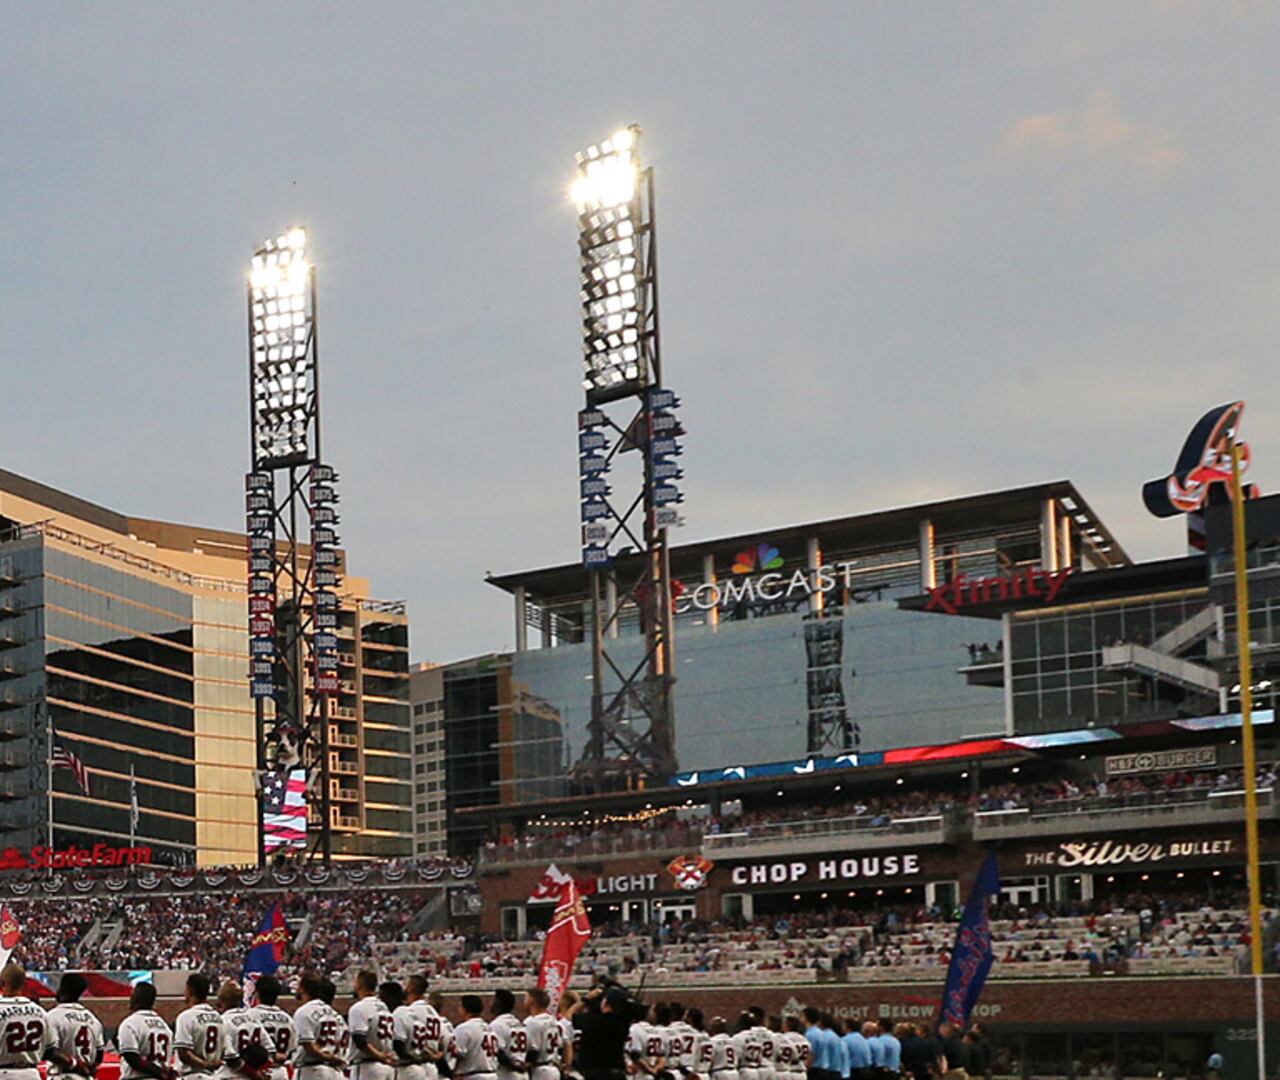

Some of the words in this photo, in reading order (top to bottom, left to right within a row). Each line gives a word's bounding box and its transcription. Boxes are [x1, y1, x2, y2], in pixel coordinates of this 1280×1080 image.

[675, 561, 857, 613] OMCAST
[924, 565, 1071, 613] xfinity
[1157, 750, 1212, 766] BURGER
[1026, 852, 1055, 865] THE
[1057, 840, 1167, 867] Silver
[1169, 840, 1232, 857] BULLET
[597, 873, 657, 894] LIGHT
[732, 861, 807, 885] CHOP
[818, 854, 920, 880] HOUSE
[878, 1004, 935, 1018] BELOW
[6, 1020, 44, 1053] 22
[74, 1026, 90, 1056] 4
[148, 1032, 169, 1062] 13
[205, 1026, 219, 1054] 8
